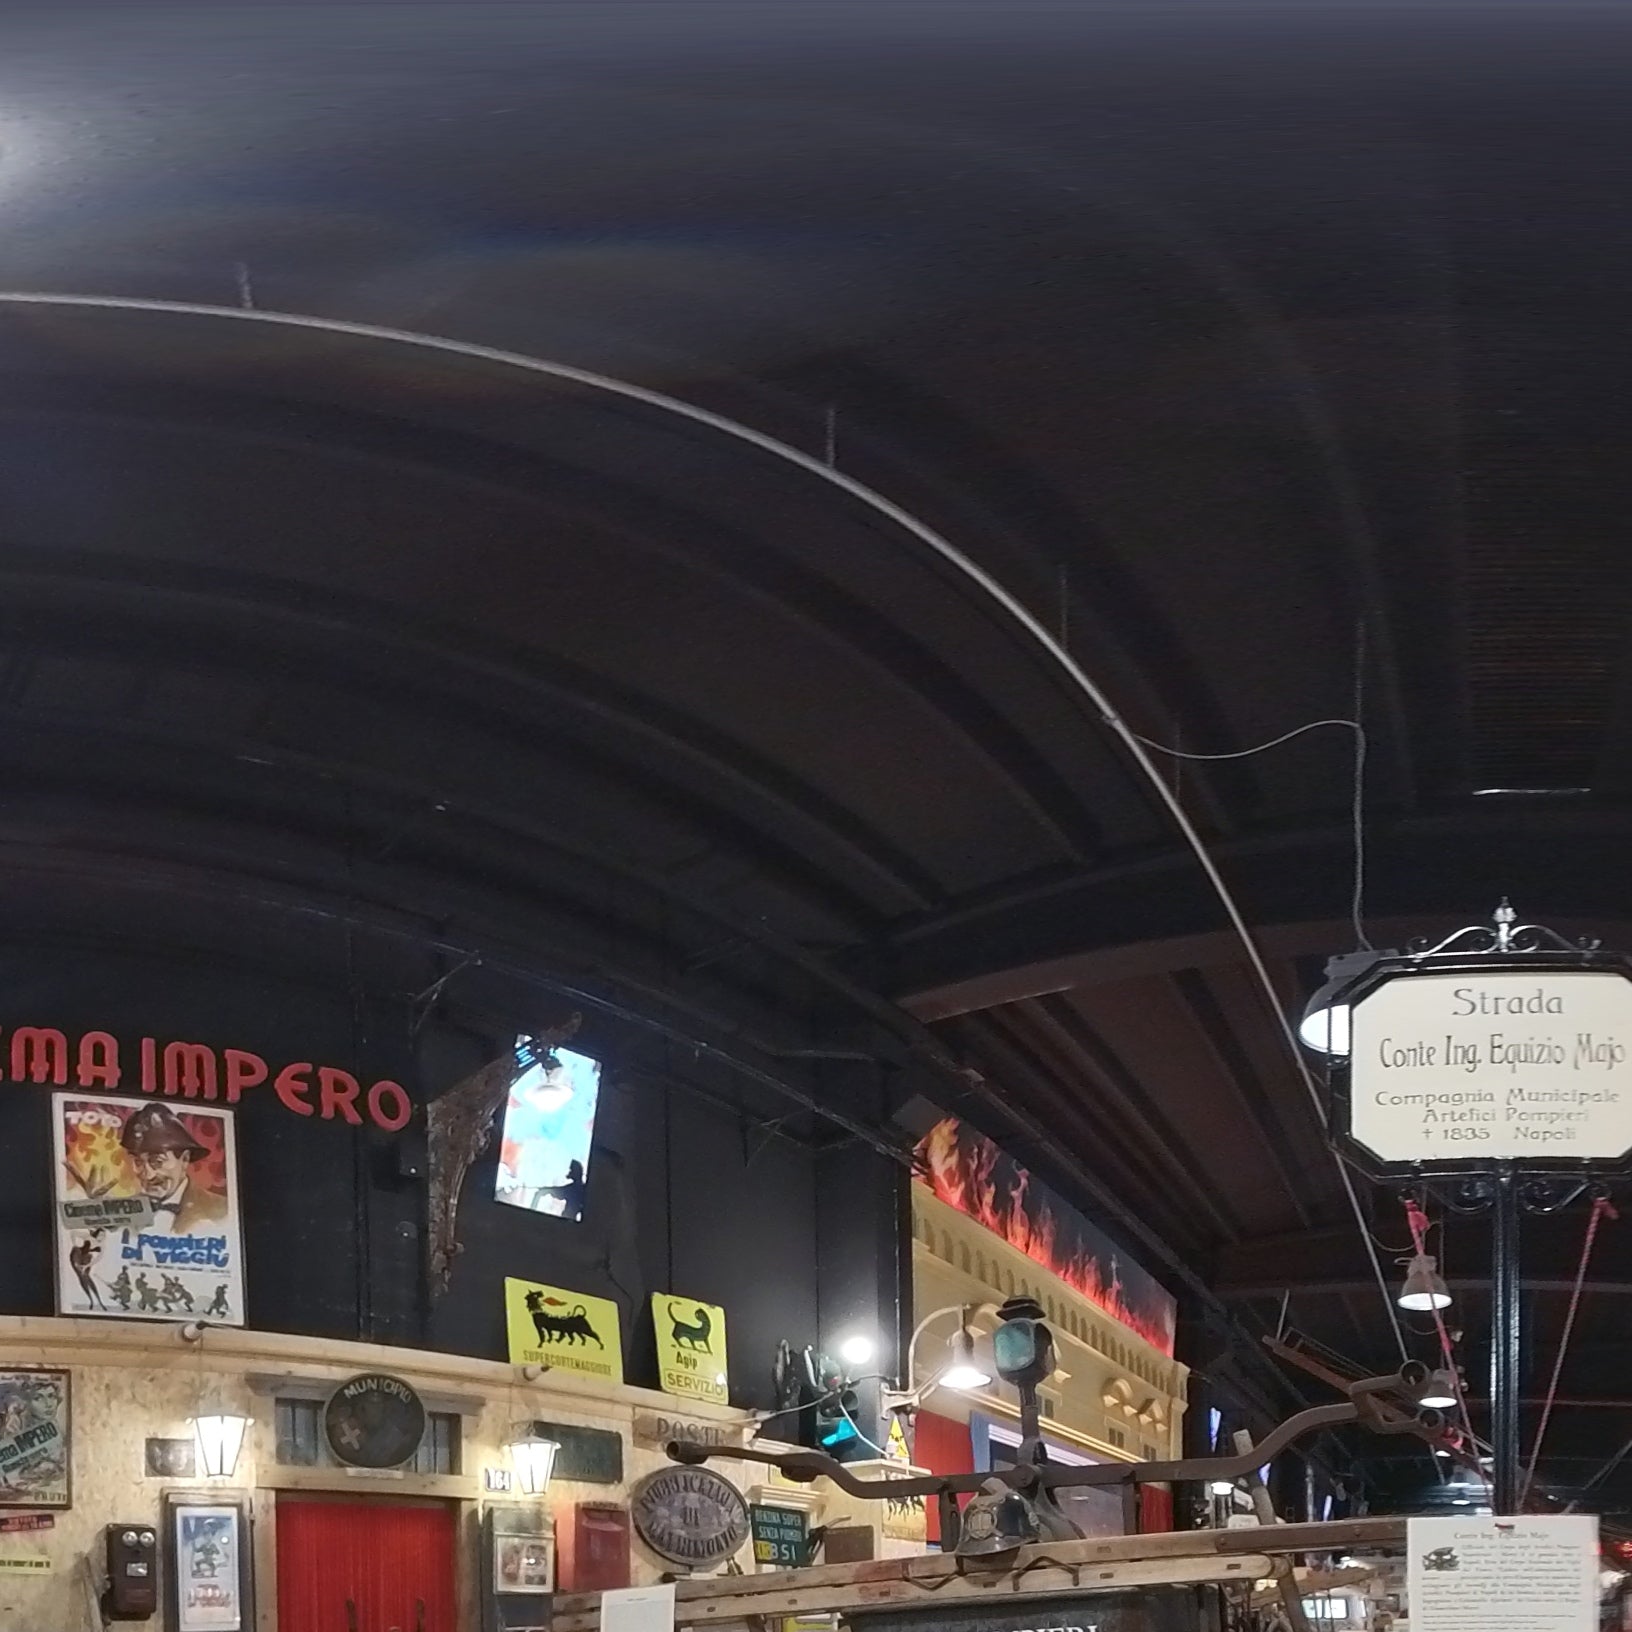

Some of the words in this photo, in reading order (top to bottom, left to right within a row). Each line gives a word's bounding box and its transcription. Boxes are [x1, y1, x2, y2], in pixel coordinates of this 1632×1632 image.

[1452, 988, 1564, 1016] Strada
[1379, 1037, 1437, 1068] Conte
[1444, 1035, 1482, 1073] Ing.
[1490, 1033, 1566, 1073] Equizio
[1573, 1033, 1625, 1070] Majo
[140, 1037, 413, 1132] IMPERO
[1375, 1088, 1495, 1107] Compagnia
[1506, 1088, 1620, 1106] Municipale
[1422, 1108, 1497, 1124] Artefici
[1505, 1107, 1589, 1124] Pompieri
[1513, 1127, 1576, 1143] Napoli
[676, 1351, 698, 1370] Agip
[667, 1373, 724, 1396] SERVIZIO
[14, 1421, 59, 1453] IMPERO
[782, 1513, 802, 1527] SUPER
[758, 1526, 779, 1540] SENZA
